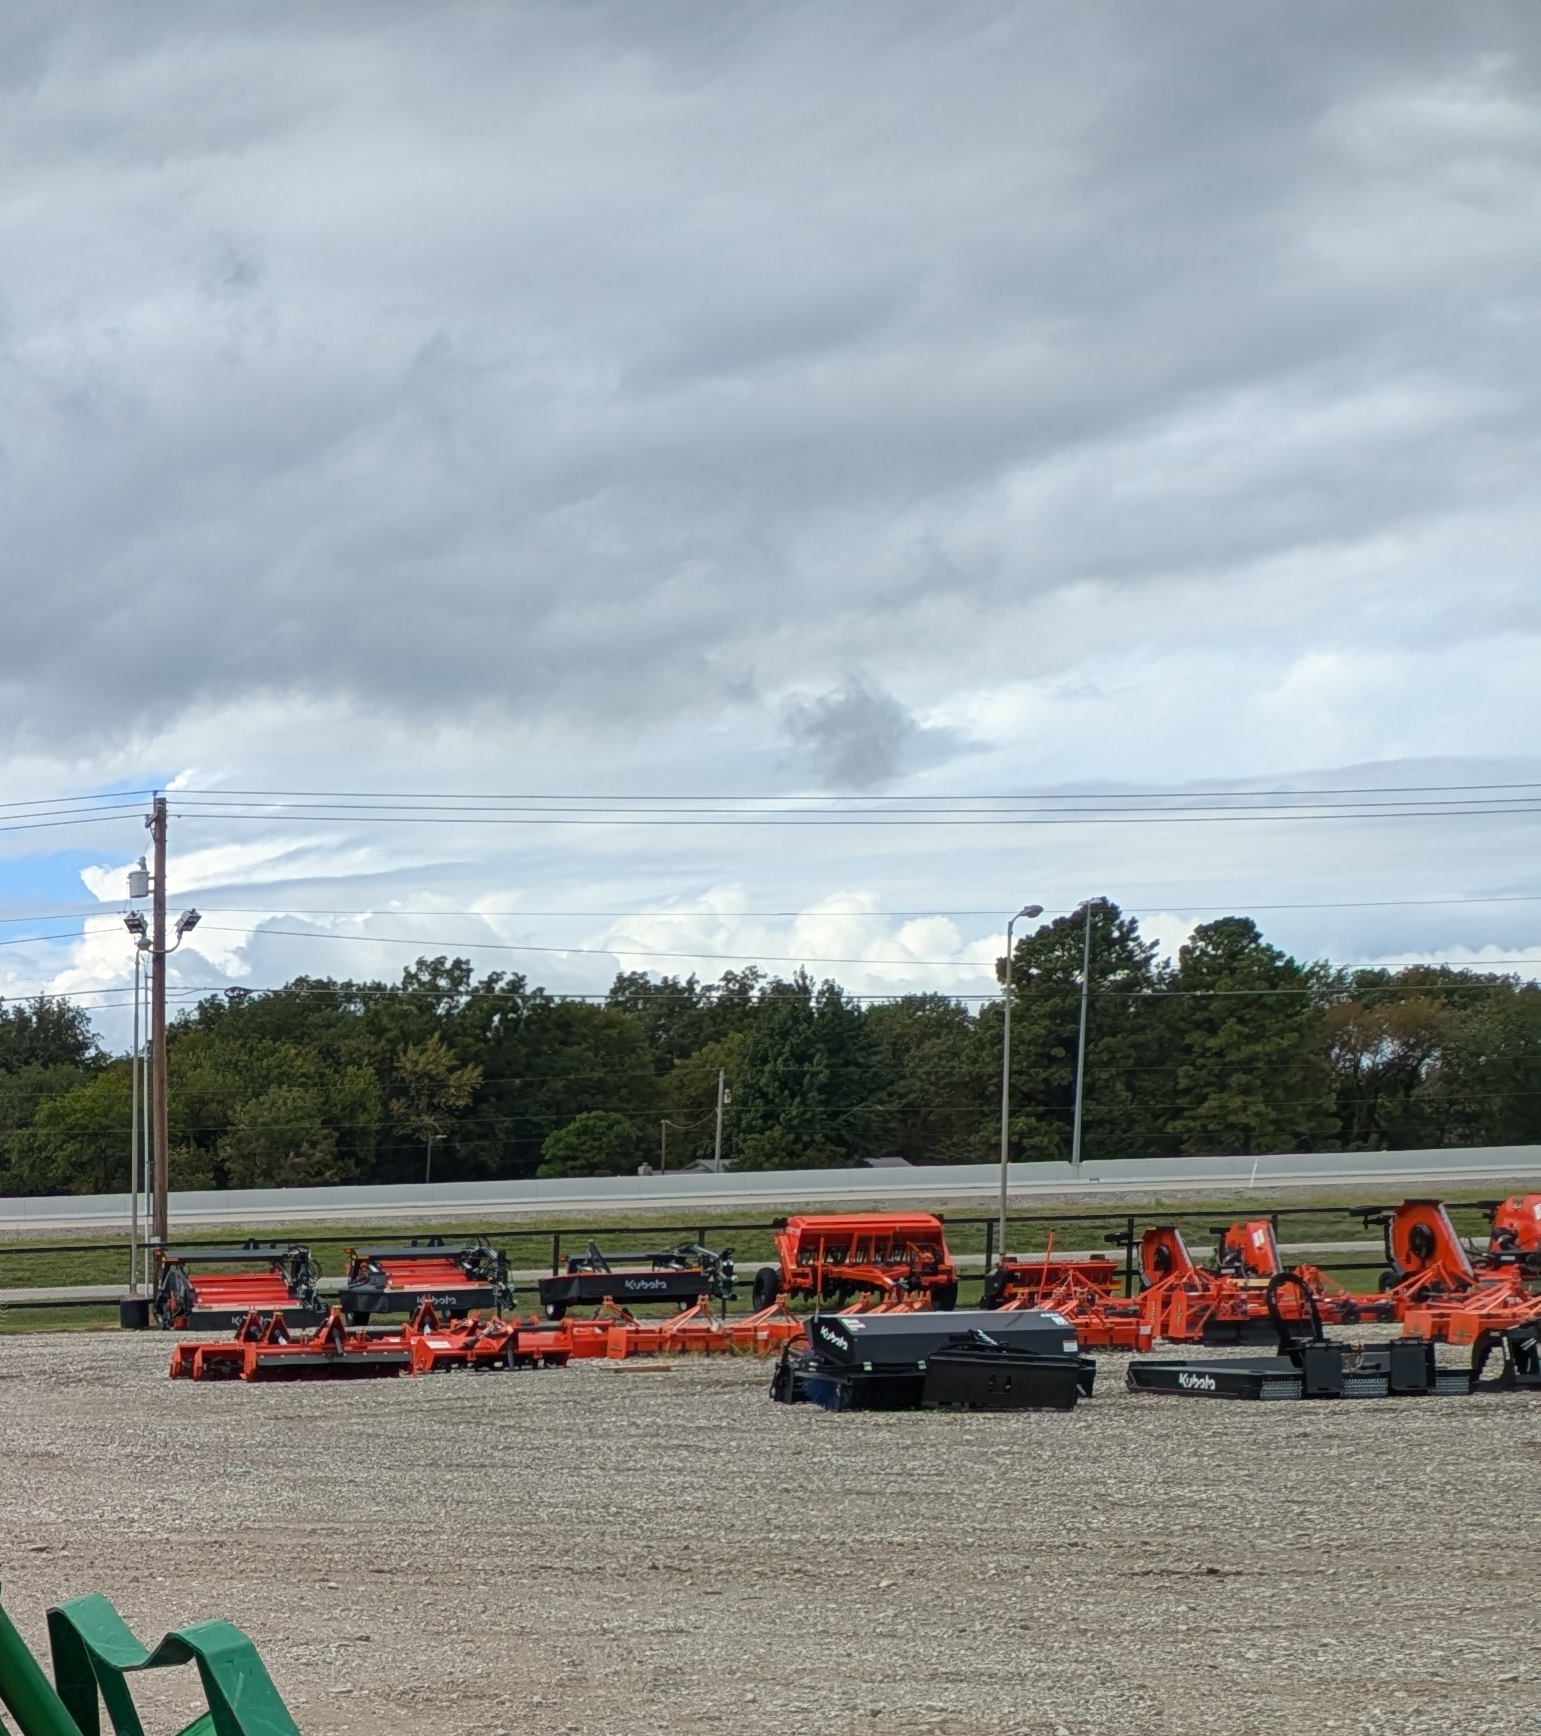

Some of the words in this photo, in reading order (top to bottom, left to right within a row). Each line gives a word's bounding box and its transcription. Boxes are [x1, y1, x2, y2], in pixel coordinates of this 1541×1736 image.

[625, 1279, 667, 1290] Kubota
[820, 1325, 848, 1351] Kubota
[1179, 1372, 1216, 1390] Kubota
